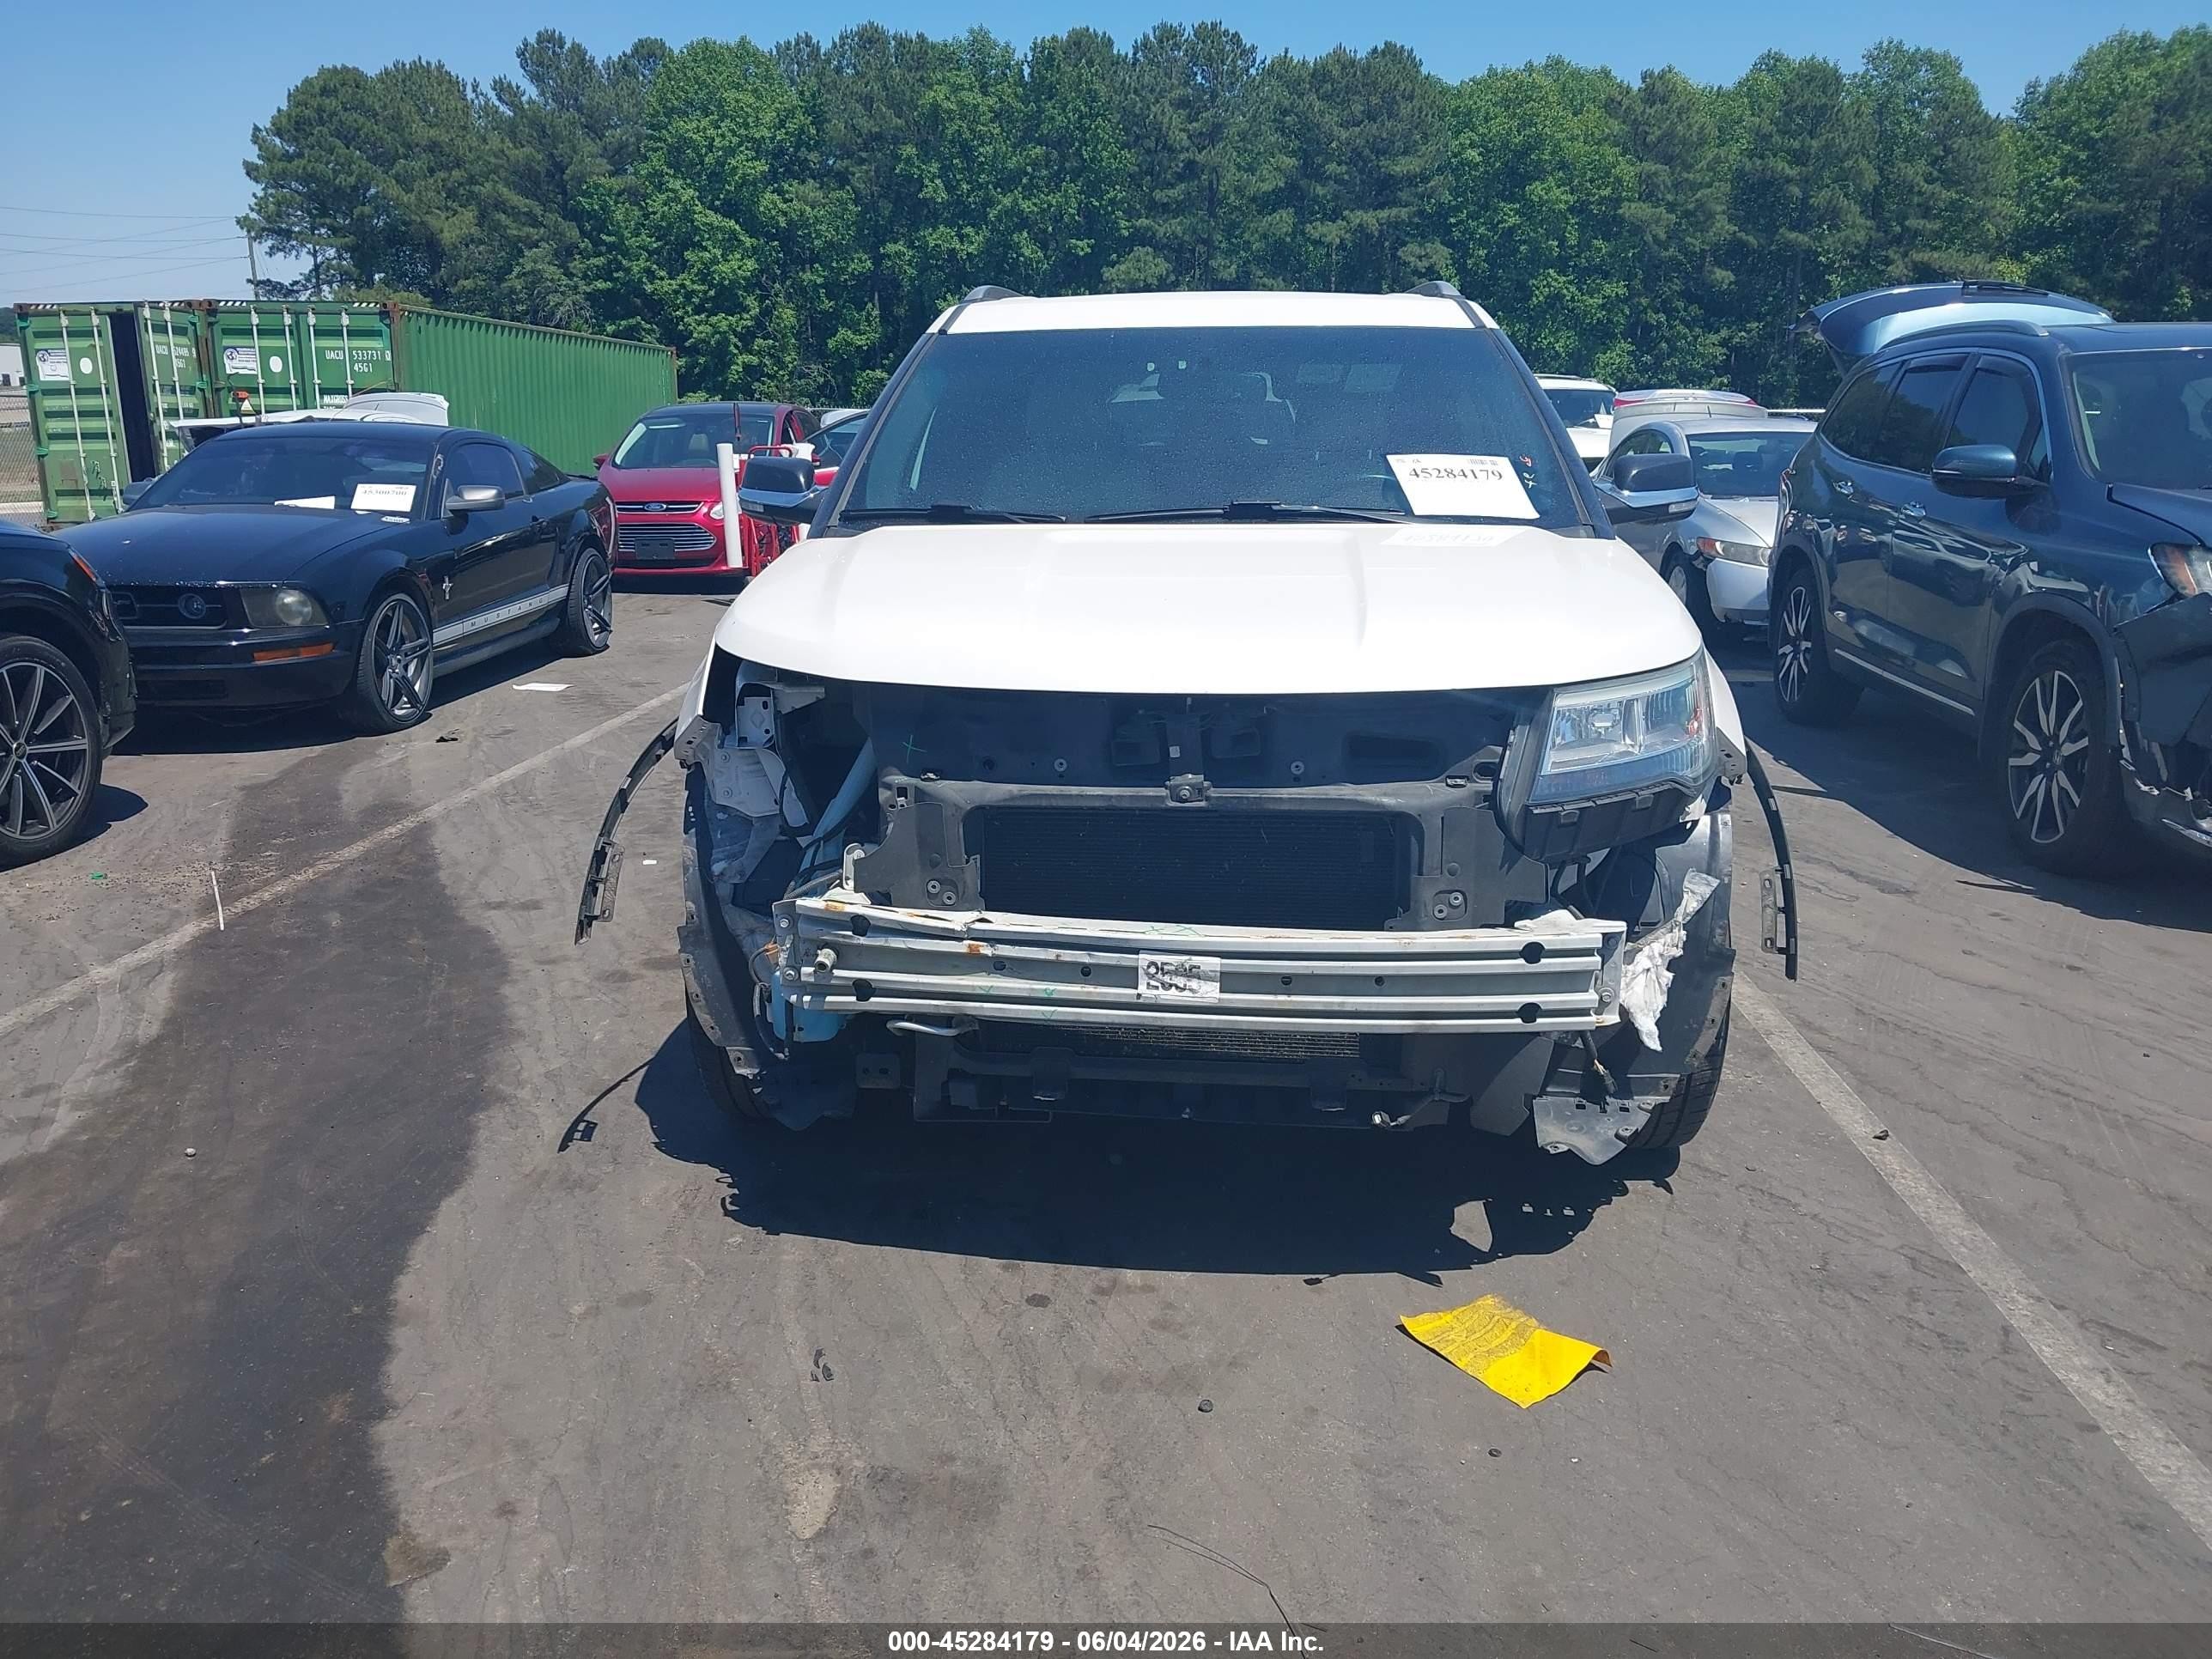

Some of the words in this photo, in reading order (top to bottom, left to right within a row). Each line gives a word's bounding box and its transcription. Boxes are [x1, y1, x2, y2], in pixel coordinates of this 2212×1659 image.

[325, 350, 343, 360] UACU
[352, 350, 381, 361] 533731
[354, 362, 373, 373] 45G1
[1408, 467, 1504, 481] 45284179
[471, 598, 544, 628] MUSTANG
